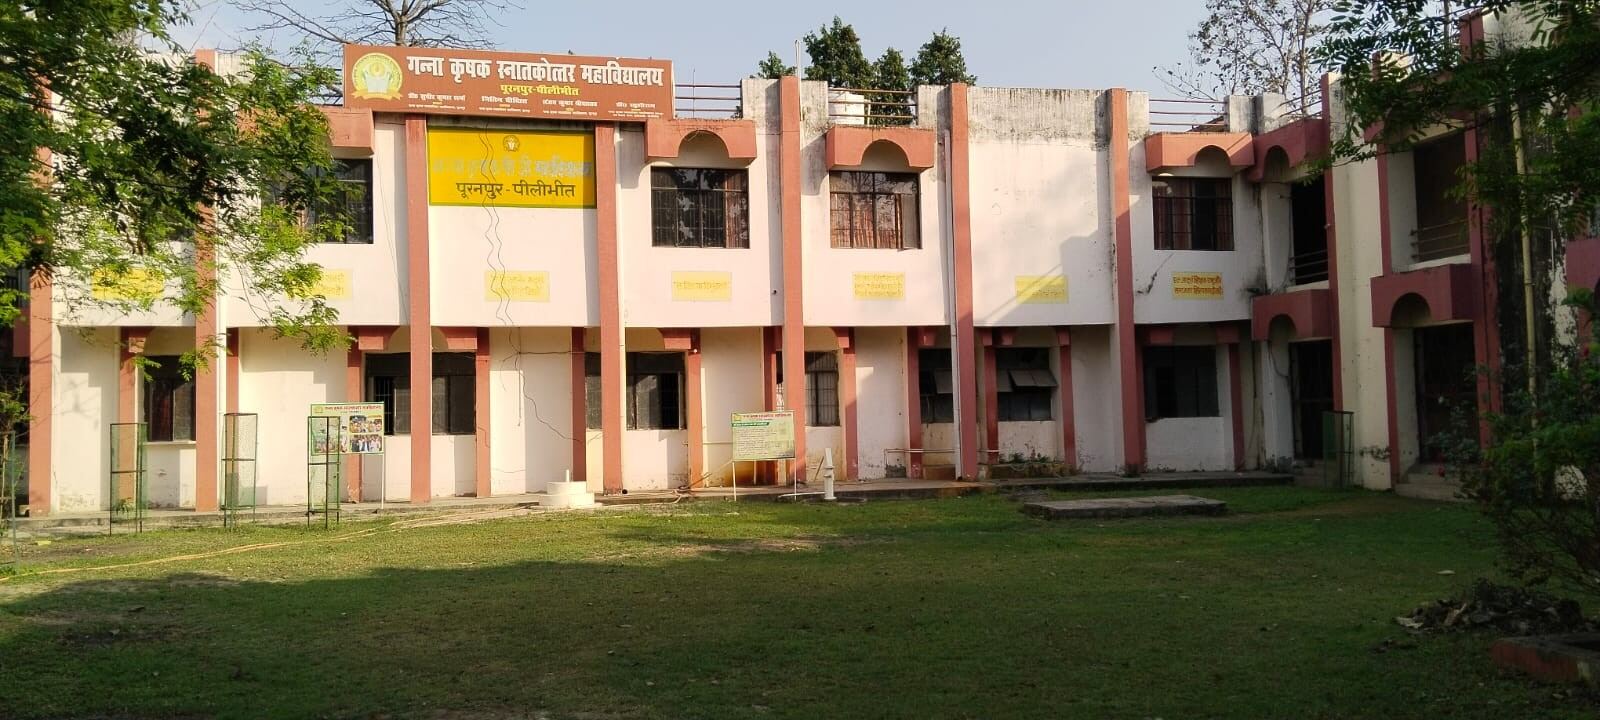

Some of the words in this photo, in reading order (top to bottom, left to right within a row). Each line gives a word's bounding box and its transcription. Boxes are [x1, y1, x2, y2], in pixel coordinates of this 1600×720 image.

[406, 55, 444, 75] गन्ना
[449, 57, 491, 83] कृषक
[497, 57, 576, 84] स्नातकोत्तर
[580, 58, 664, 86] महाविद्यालय
[456, 182, 503, 199] पूरनपुर
[512, 180, 575, 197] पीलीभीत
